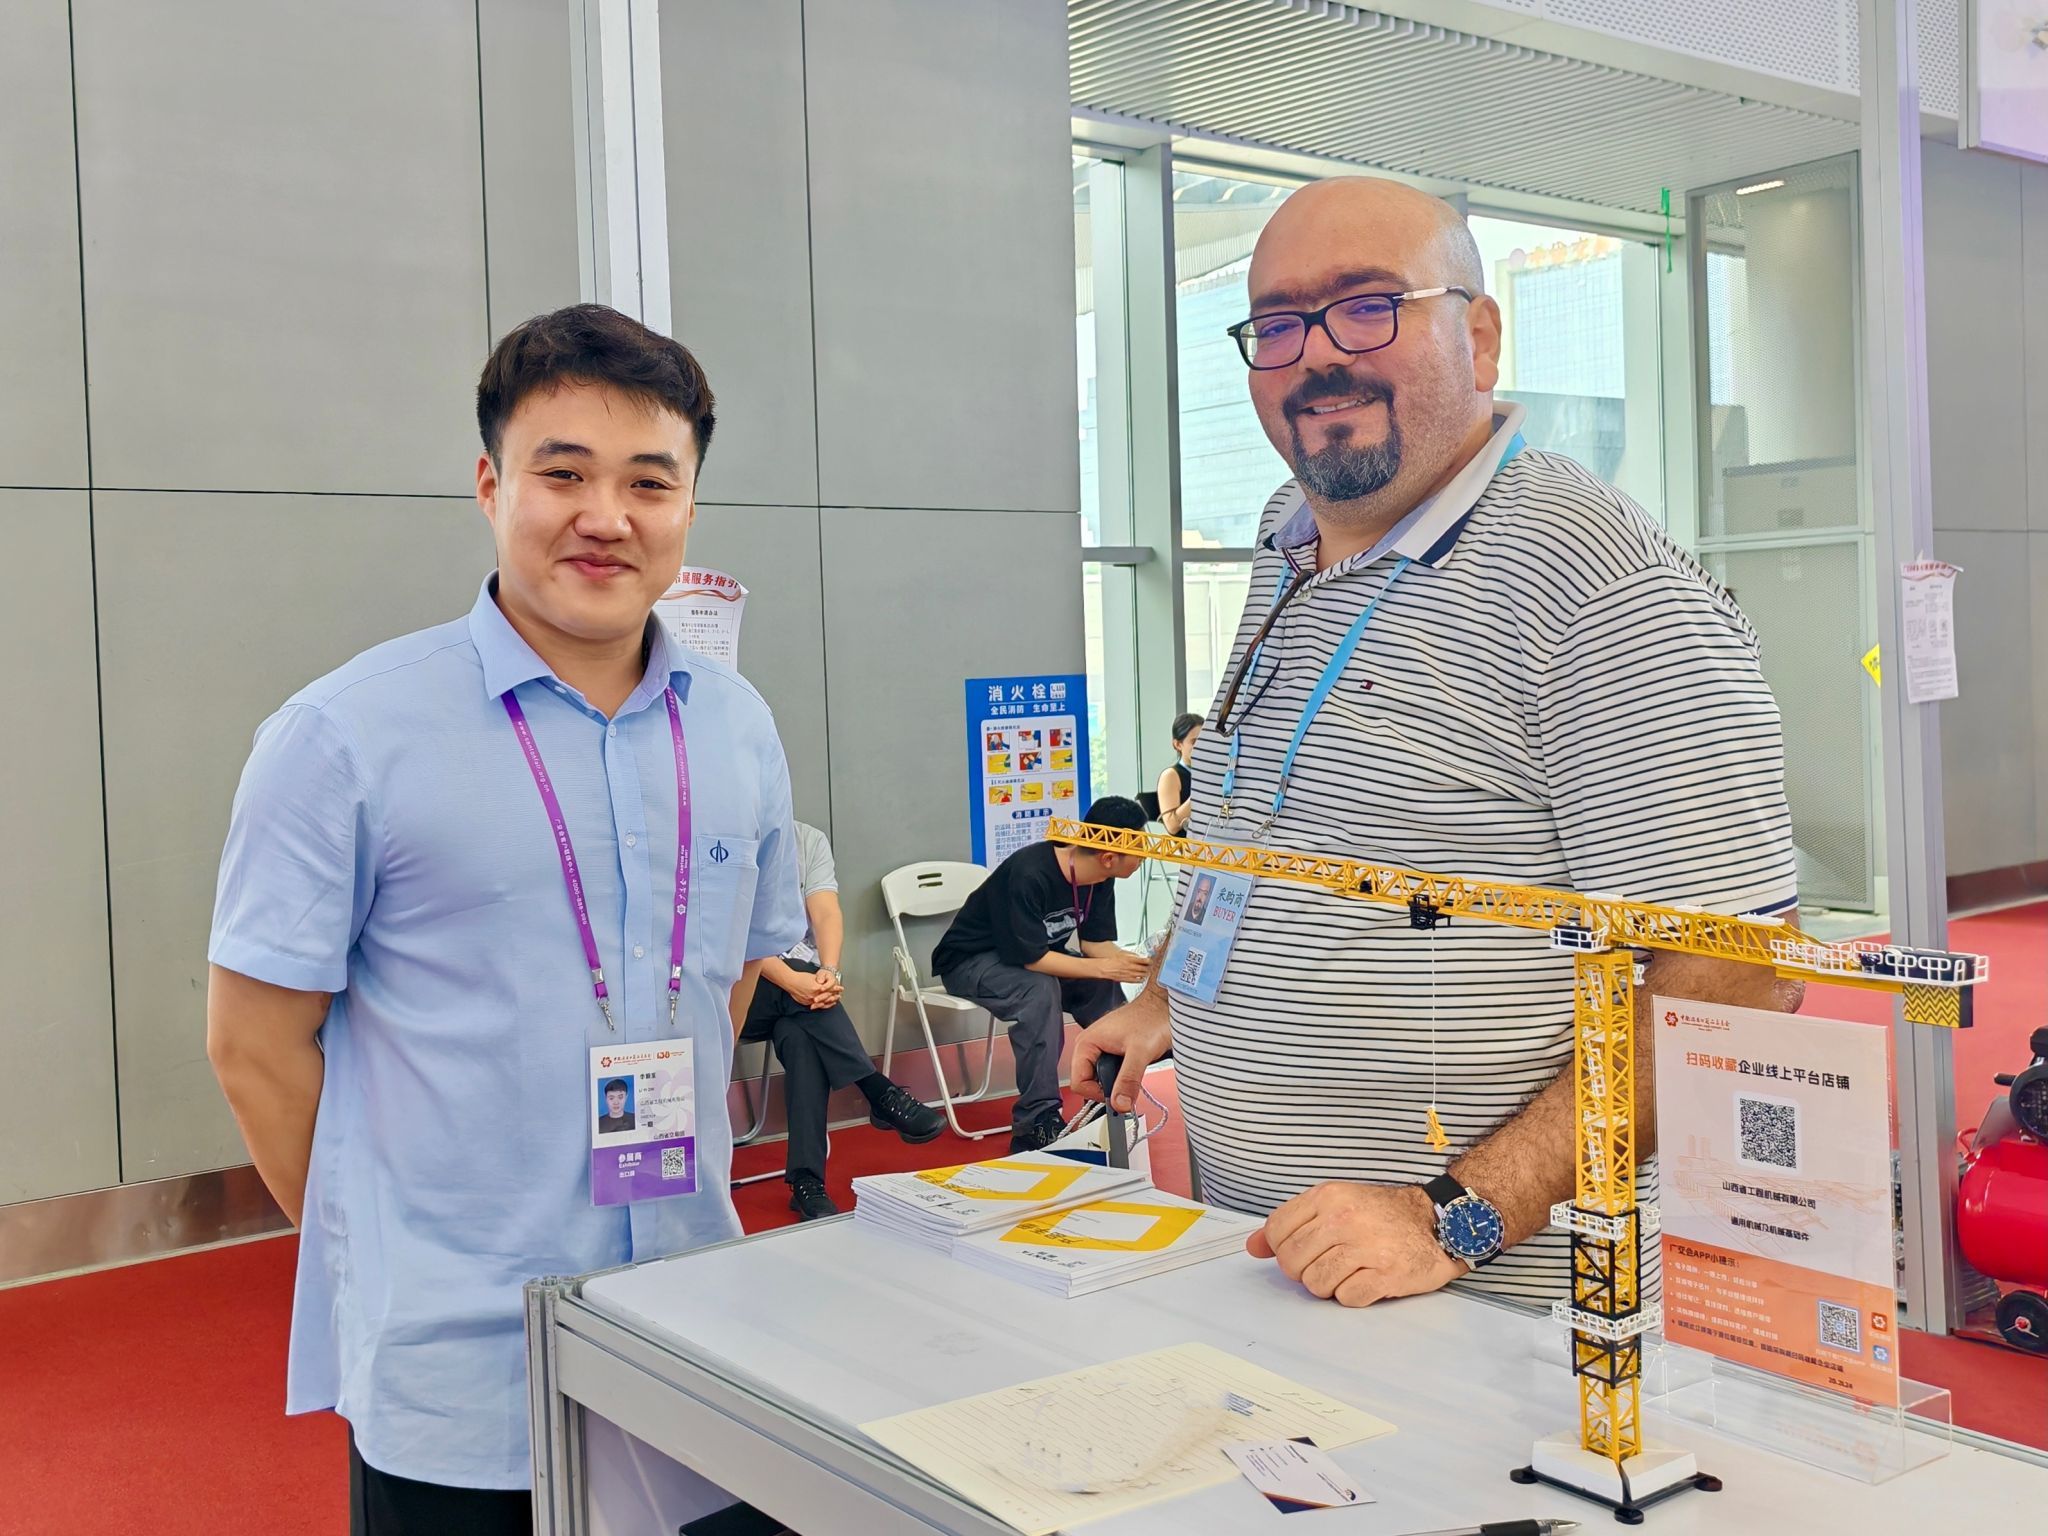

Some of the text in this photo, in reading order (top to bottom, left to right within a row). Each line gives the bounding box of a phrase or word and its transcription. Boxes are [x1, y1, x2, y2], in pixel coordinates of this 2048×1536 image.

[988, 683, 1046, 702] 消火栓
[990, 705, 1025, 715] 全民消防
[1217, 887, 1244, 907] 采购商
[1213, 906, 1236, 923] BUYER
[1686, 1051, 1850, 1090] 扫码收藏企业线上平台店铺
[1722, 1181, 1816, 1209] 山西省工程机械有限公司
